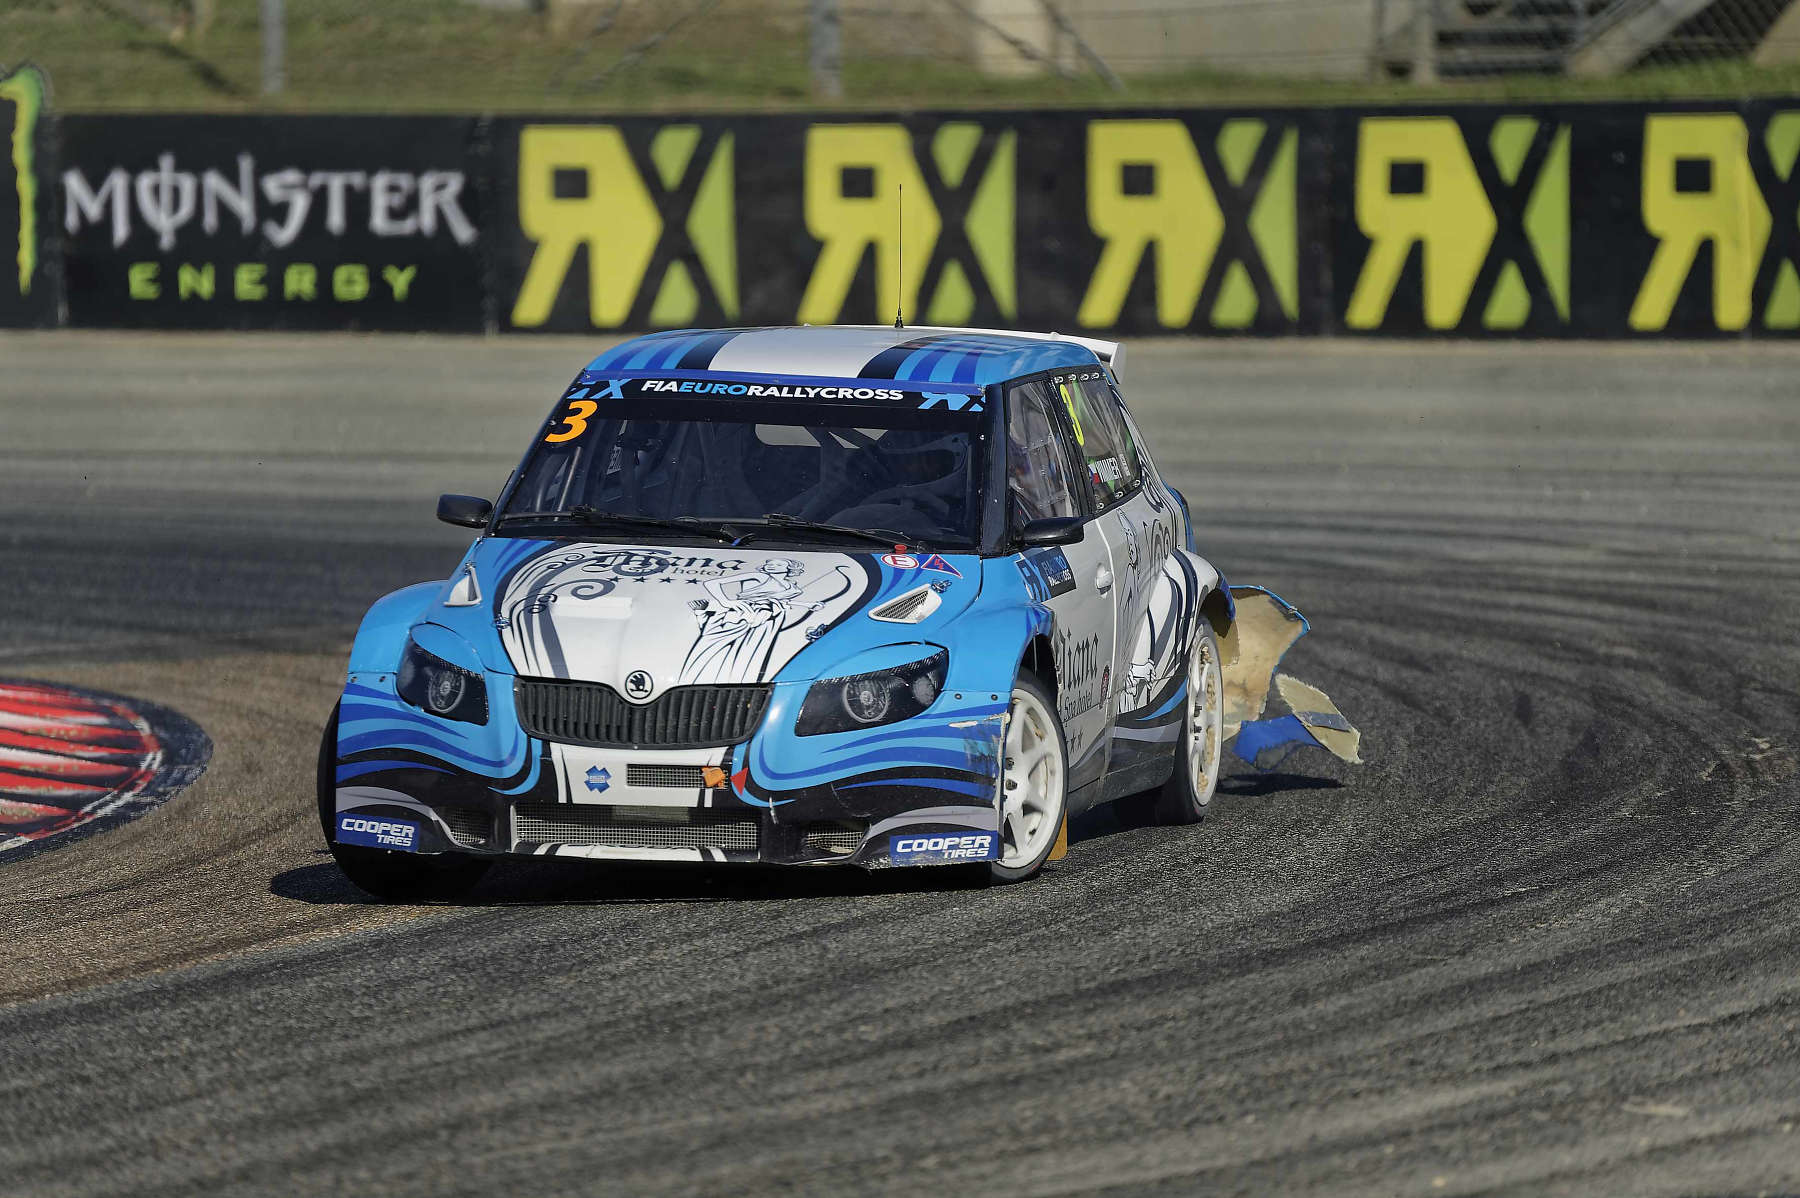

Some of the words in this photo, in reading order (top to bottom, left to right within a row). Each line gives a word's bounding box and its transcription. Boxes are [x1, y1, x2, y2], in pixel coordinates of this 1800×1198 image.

[62, 152, 478, 252] MONSTER
[128, 262, 418, 301] ENERGY
[545, 400, 598, 442] 3
[672, 567, 726, 577] hotel
[341, 818, 415, 838] COOPER
[376, 834, 413, 847] TIRES
[896, 835, 992, 853] COOPER
[942, 848, 990, 859] TIRES
